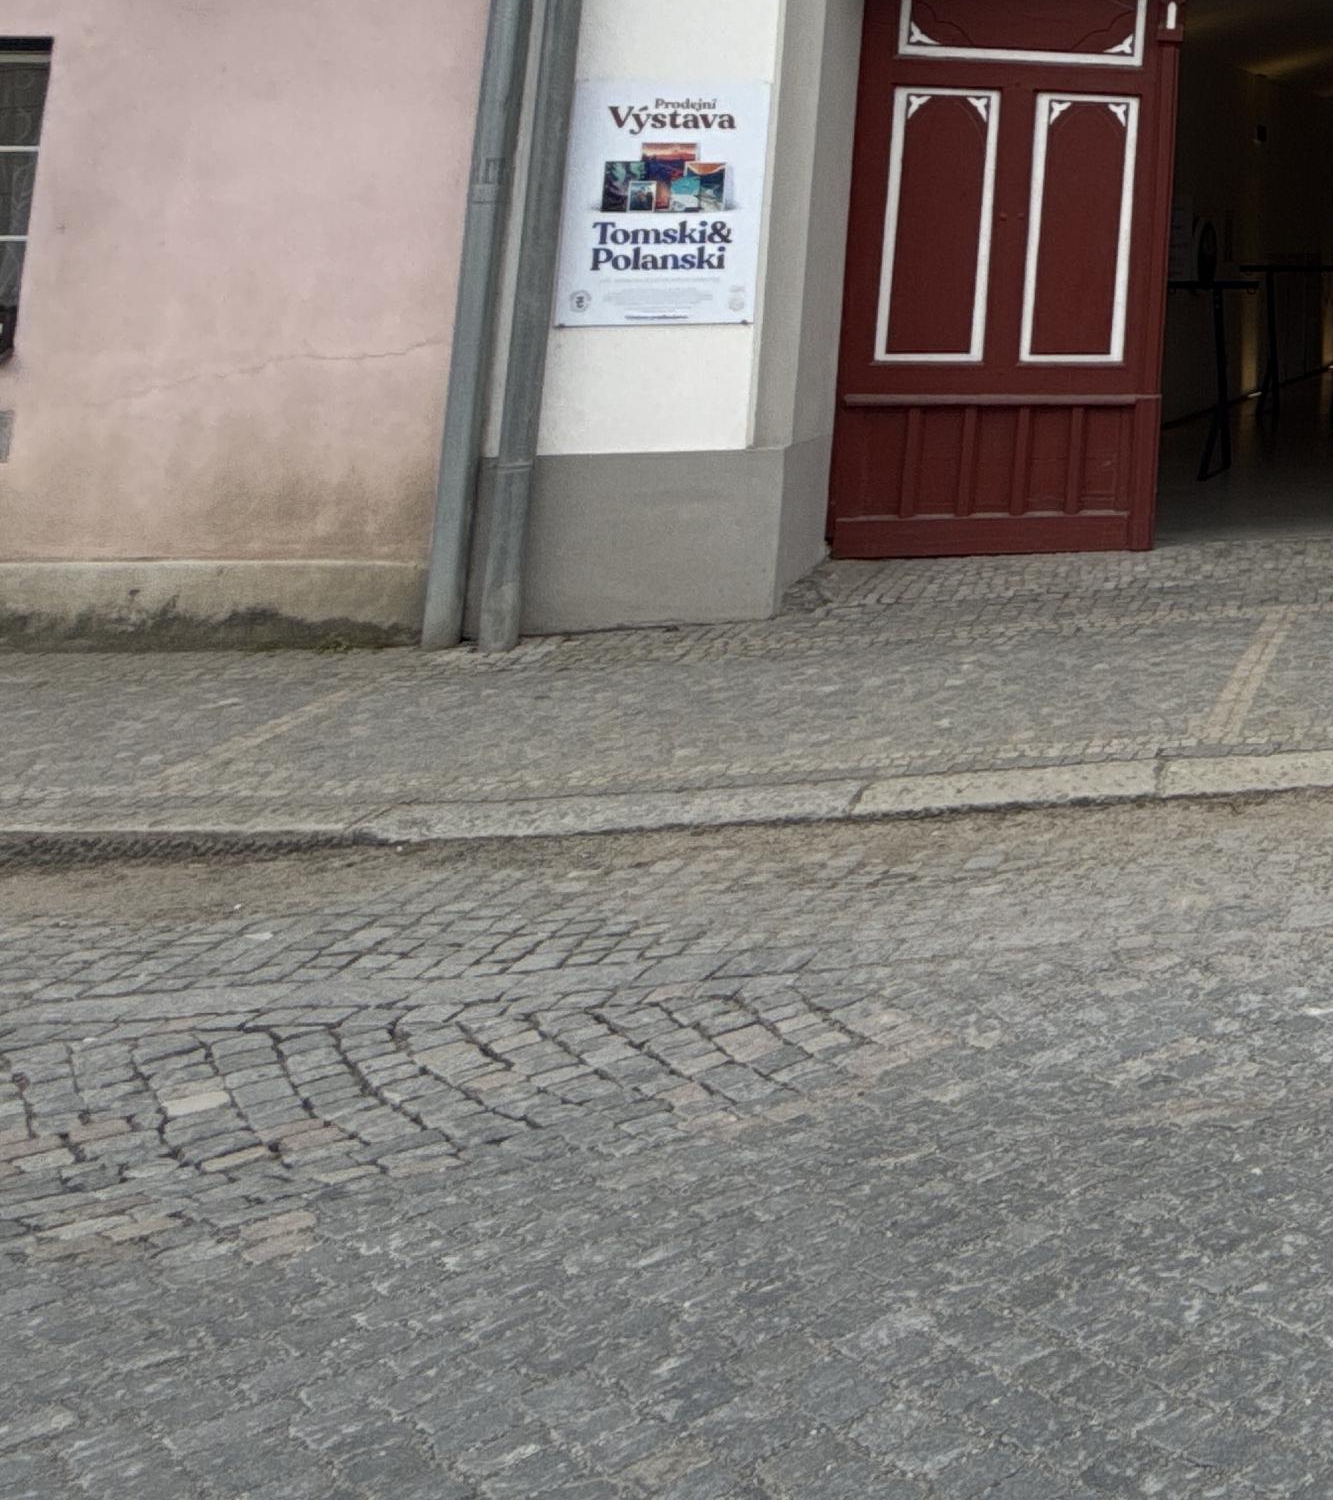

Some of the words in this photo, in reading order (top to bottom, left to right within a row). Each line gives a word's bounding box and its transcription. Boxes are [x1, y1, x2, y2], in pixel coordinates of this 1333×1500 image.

[655, 98, 717, 110] Prodejní
[608, 105, 736, 135] Výstava
[592, 220, 733, 245] Tomski&
[590, 246, 726, 271] Polanski
